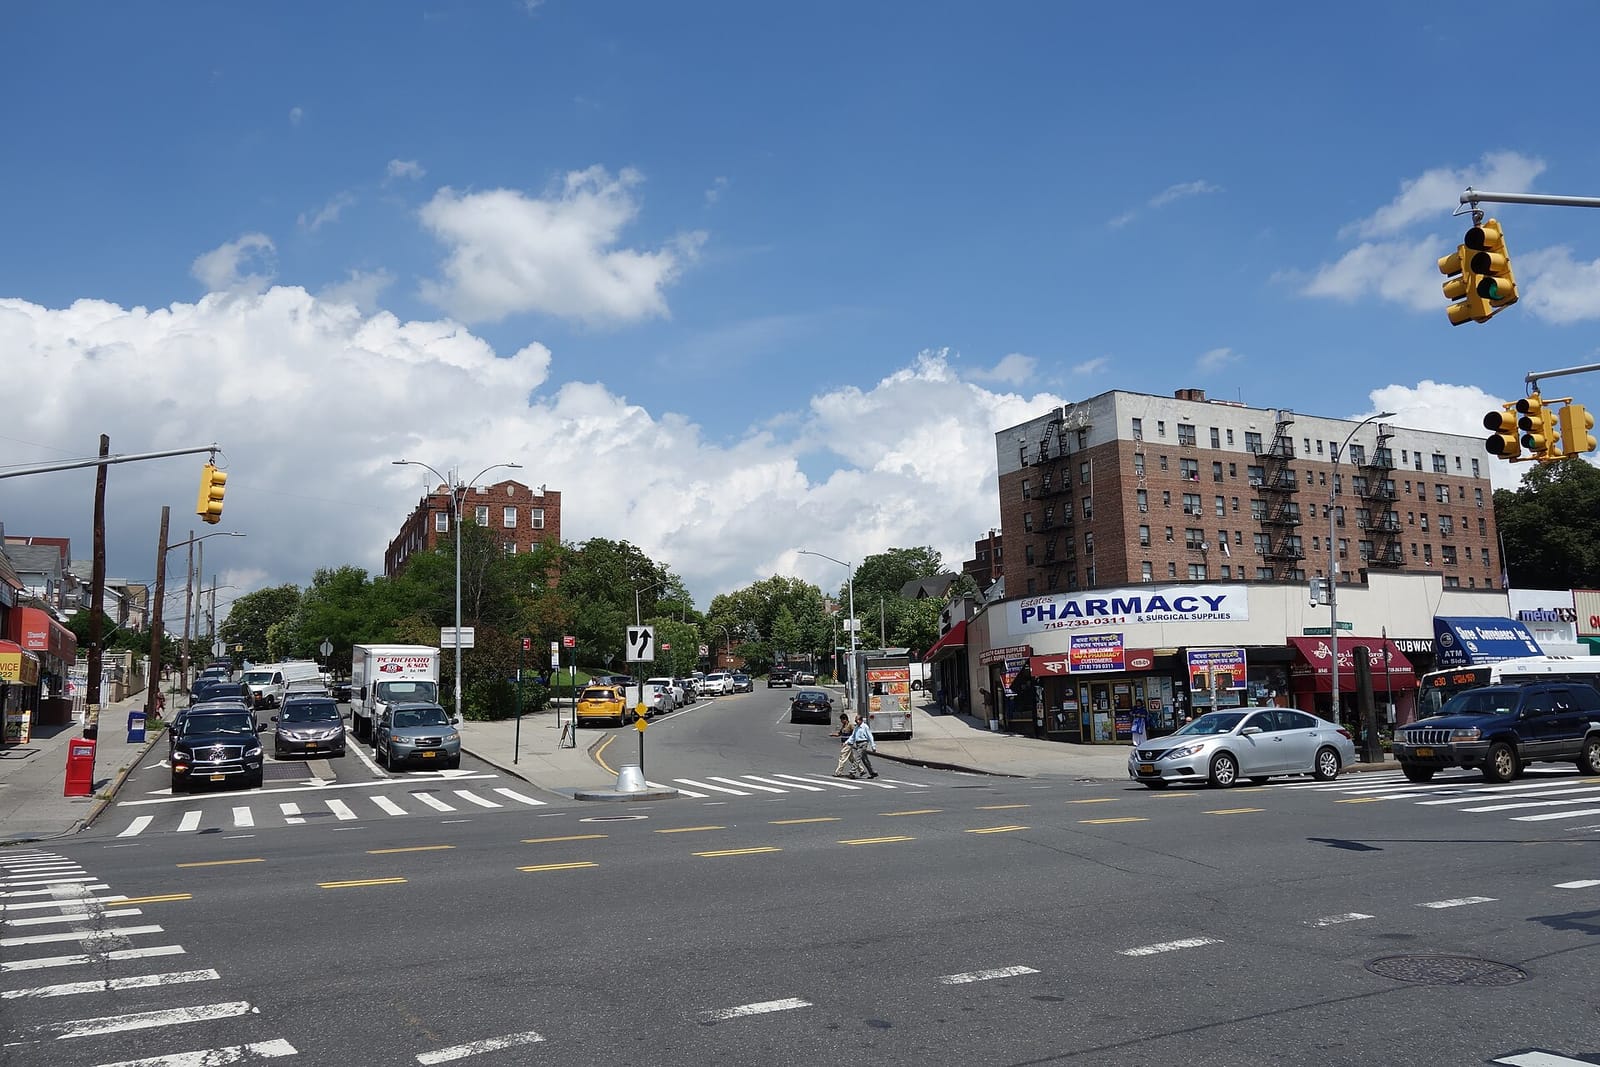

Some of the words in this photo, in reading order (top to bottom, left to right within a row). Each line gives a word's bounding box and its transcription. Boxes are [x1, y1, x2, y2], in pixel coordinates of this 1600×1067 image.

[1021, 595, 1227, 624] PHARMACY
[1044, 617, 1126, 629] 718-739-0311
[1146, 614, 1189, 622] SURGICAL
[1394, 640, 1433, 652] SUBWAY
